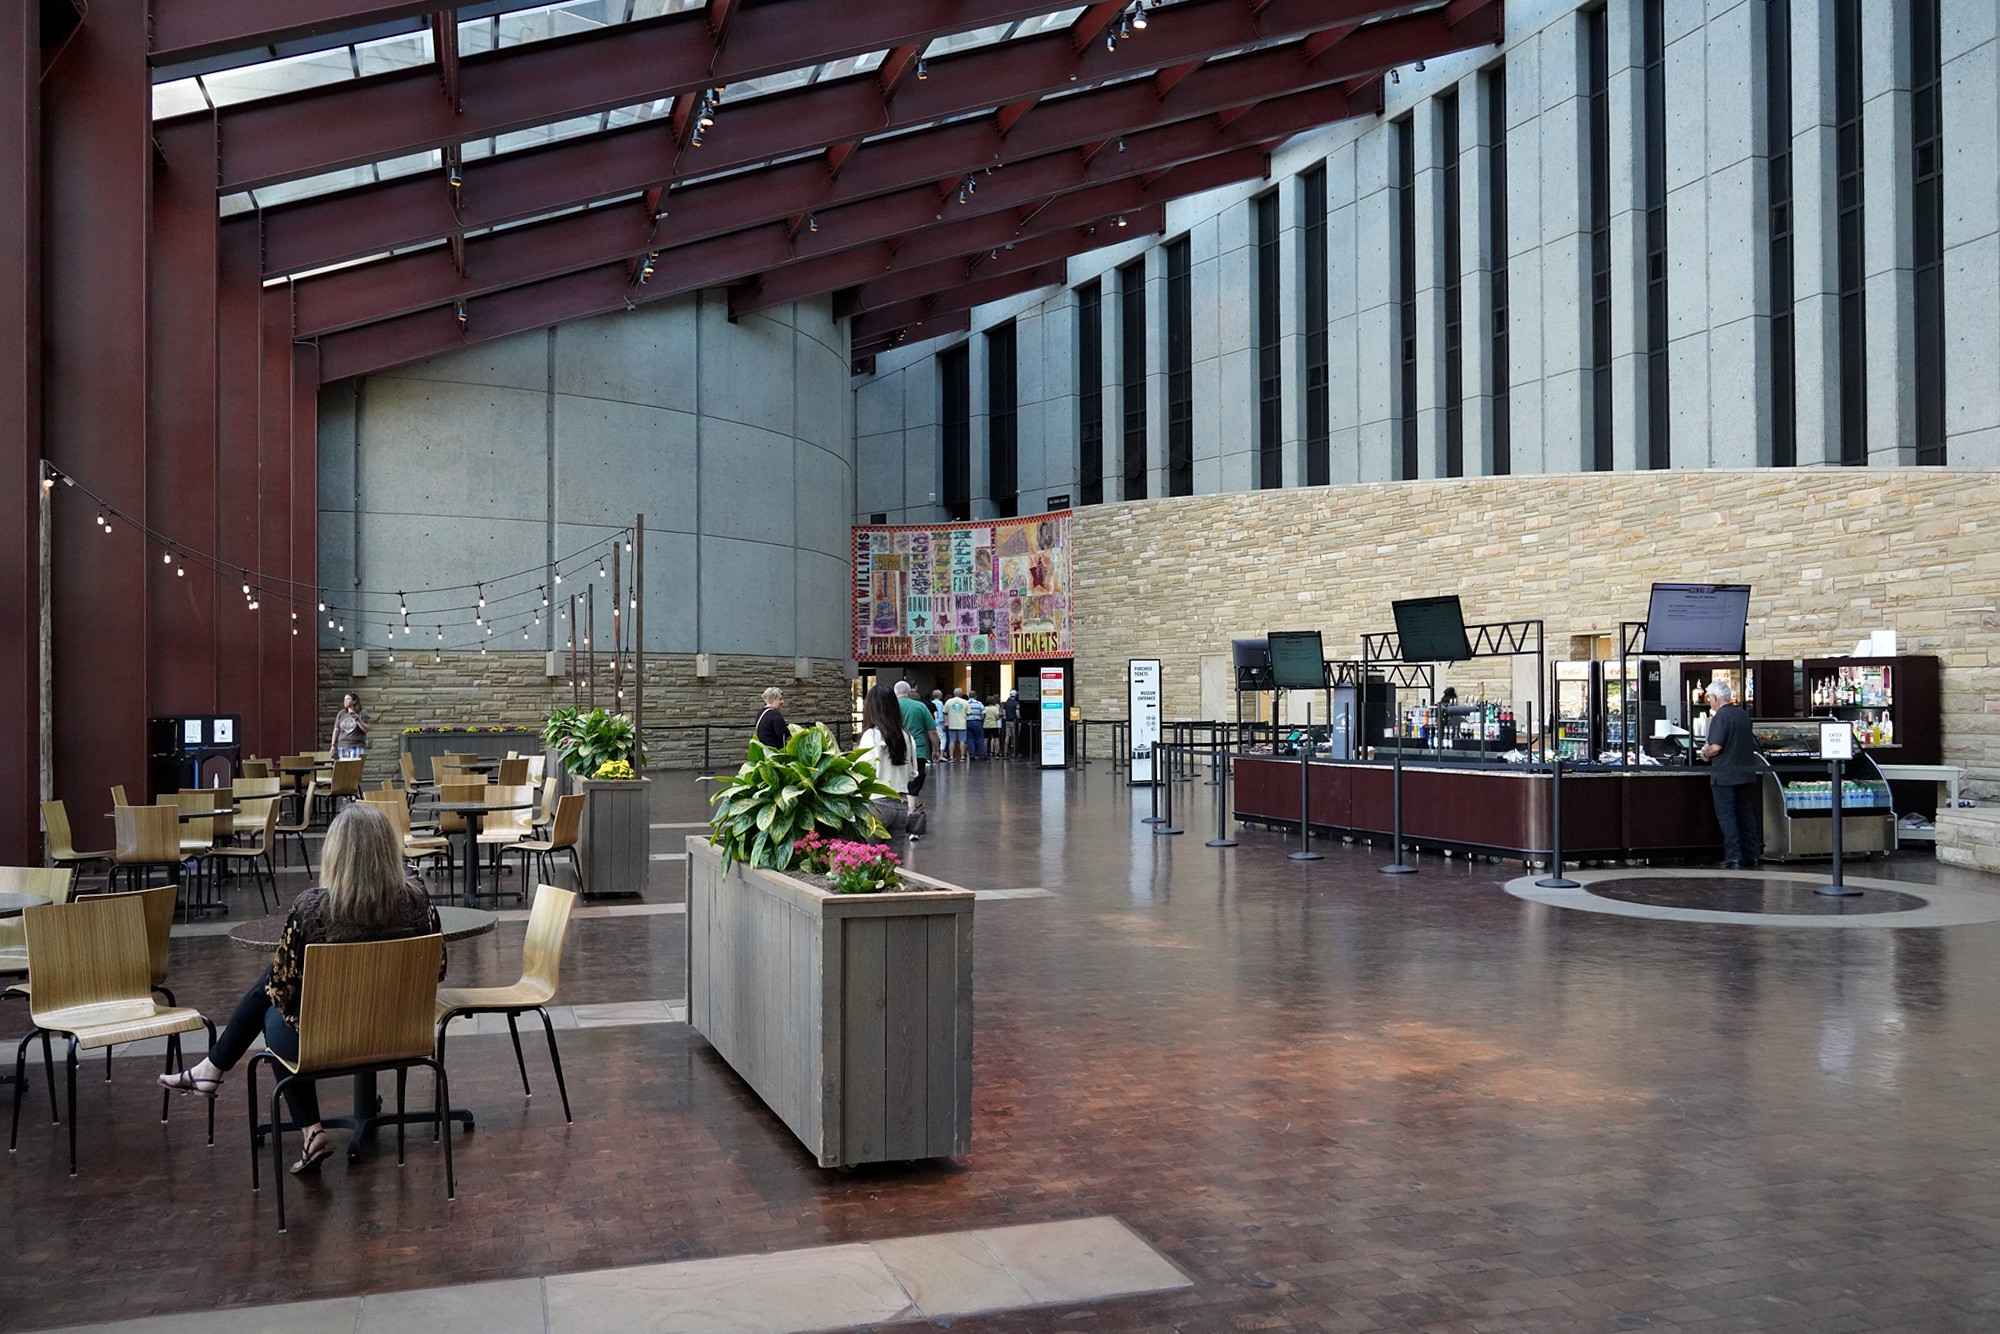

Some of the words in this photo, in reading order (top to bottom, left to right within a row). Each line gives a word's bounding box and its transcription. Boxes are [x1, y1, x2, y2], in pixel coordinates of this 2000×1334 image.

[858, 532, 871, 599] WILLIAMS
[953, 577, 973, 593] FAME
[907, 596, 932, 612] HONOR
[956, 594, 978, 610] MUSIC
[858, 602, 871, 626] HANK
[870, 636, 913, 656] THEATER
[1013, 631, 1058, 653] TICKETS
